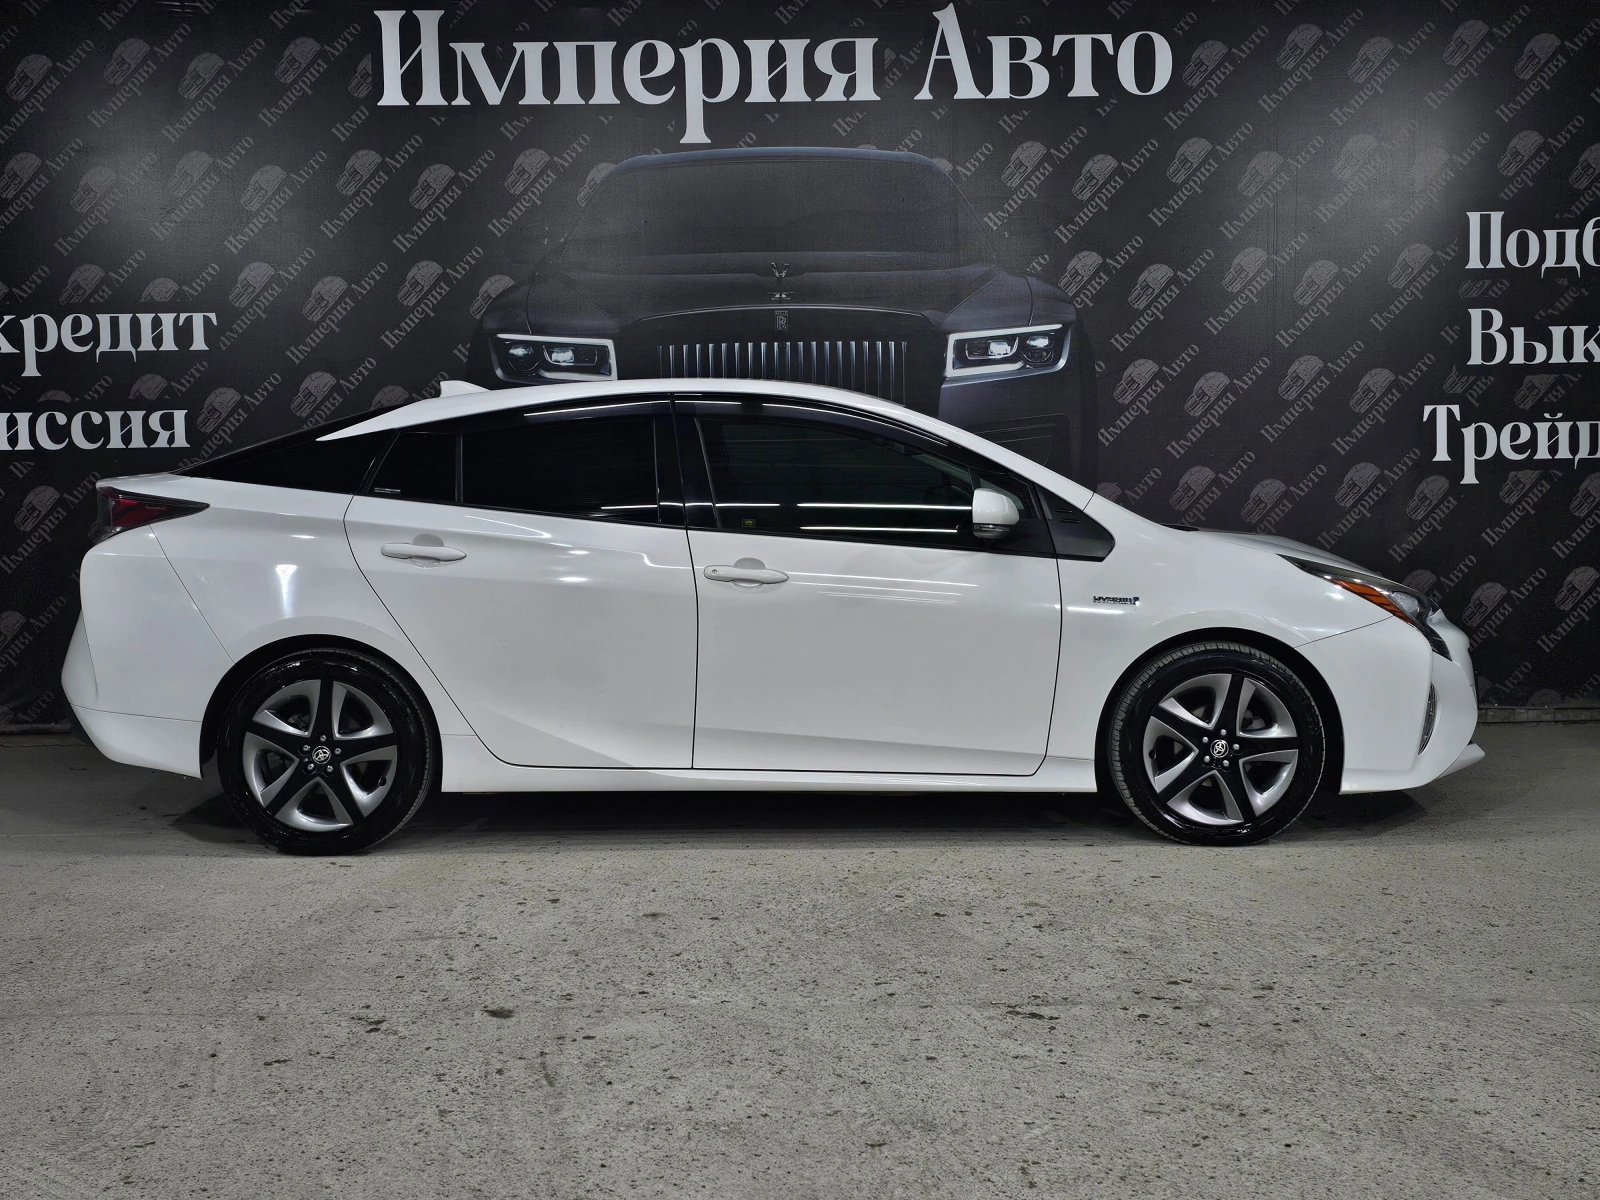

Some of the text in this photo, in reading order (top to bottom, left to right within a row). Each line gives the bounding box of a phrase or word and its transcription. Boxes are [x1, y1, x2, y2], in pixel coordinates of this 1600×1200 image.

[57, 39, 95, 78] Авто
[88, 60, 157, 129] Империя
[153, 23, 192, 62] Авто
[162, 37, 265, 143] Империя Авто
[258, 59, 327, 127] Империя
[323, 22, 362, 61] Авто
[374, 3, 1172, 143] Империя Авто
[1162, 62, 1234, 129] Империя
[1231, 25, 1270, 64] Авто
[1257, 9, 1365, 113] Империя Авто
[1328, 22, 1436, 126] Империя Авто
[1422, 5, 1530, 110] Империя Авто
[1494, 56, 1566, 124] Империя
[46, 138, 84, 176] Авто
[319, 171, 388, 238] Империя
[384, 134, 422, 173] Авто
[487, 169, 556, 237] Империя
[552, 132, 590, 171] Авто
[956, 140, 995, 178] Авто
[983, 125, 1089, 229] Империя Авто
[1147, 122, 1255, 226] Империя Авто
[1452, 133, 1491, 171] Авто
[1546, 116, 1585, 154] Авто
[150, 136, 254, 240] Империя Авто
[224, 149, 327, 254] Империя Авто
[392, 148, 495, 252] Империя Авто
[1053, 138, 1160, 242] Империя Авто
[1218, 136, 1326, 239] Империя Авто
[13, 266, 52, 304] Авто
[109, 249, 147, 288] Авто
[181, 263, 220, 301] Авто
[277, 247, 315, 285] Авто
[380, 245, 483, 349] Империя Авто
[1107, 235, 1146, 273] Авто
[1110, 249, 1217, 351] Империя Авто
[1203, 232, 1310, 335] Империя Авто
[1274, 245, 1381, 348] Империя Авто
[1368, 265, 1439, 331] Империя
[285, 261, 388, 364] Империя Авто
[1467, 309, 1600, 365] Вык
[77, 375, 113, 400] вто
[170, 360, 208, 398] Авто
[243, 373, 281, 411] Авто
[338, 357, 376, 395] Авто
[1095, 344, 1201, 446] Империя Авто
[1165, 357, 1272, 459] Империя Авто
[1259, 340, 1366, 442] Империя Авто
[1330, 390, 1401, 456] Империя
[1398, 354, 1437, 391] Авто
[0, 410, 190, 450] иссия
[1220, 451, 1258, 489] Авто
[0, 507, 67, 574] Империя
[63, 472, 101, 509] Авто
[1291, 465, 1329, 502] Авто
[1315, 448, 1421, 549] Империя Авто
[1386, 497, 1457, 562] Империя
[1477, 481, 1548, 547] Империя
[29, 595, 67, 632] Авто
[1439, 553, 1477, 592] Авто
[1509, 569, 1547, 606] Авто
